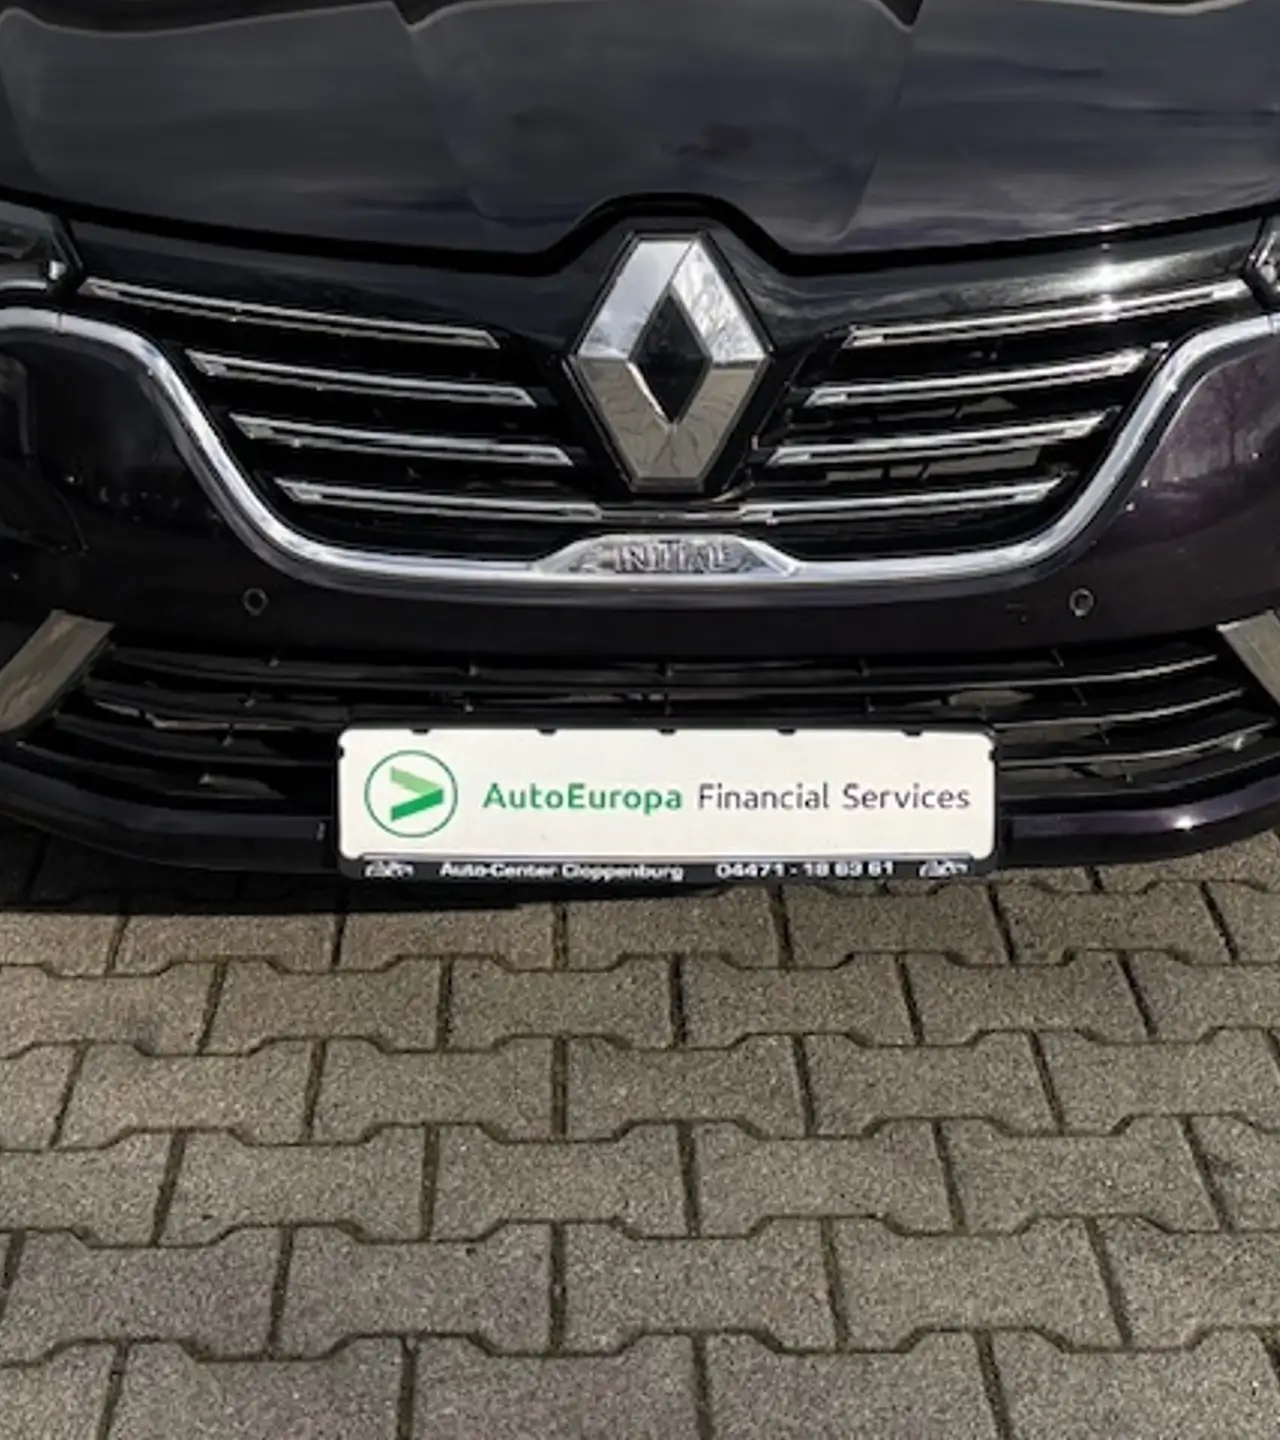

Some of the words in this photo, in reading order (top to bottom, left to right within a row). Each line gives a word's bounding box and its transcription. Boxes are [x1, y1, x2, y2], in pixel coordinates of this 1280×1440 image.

[482, 782, 683, 815] AutoEuropa
[698, 782, 830, 810] Financial
[842, 783, 971, 810] Services
[439, 861, 557, 878] Auto-Center
[561, 862, 684, 881] Cloppenburg
